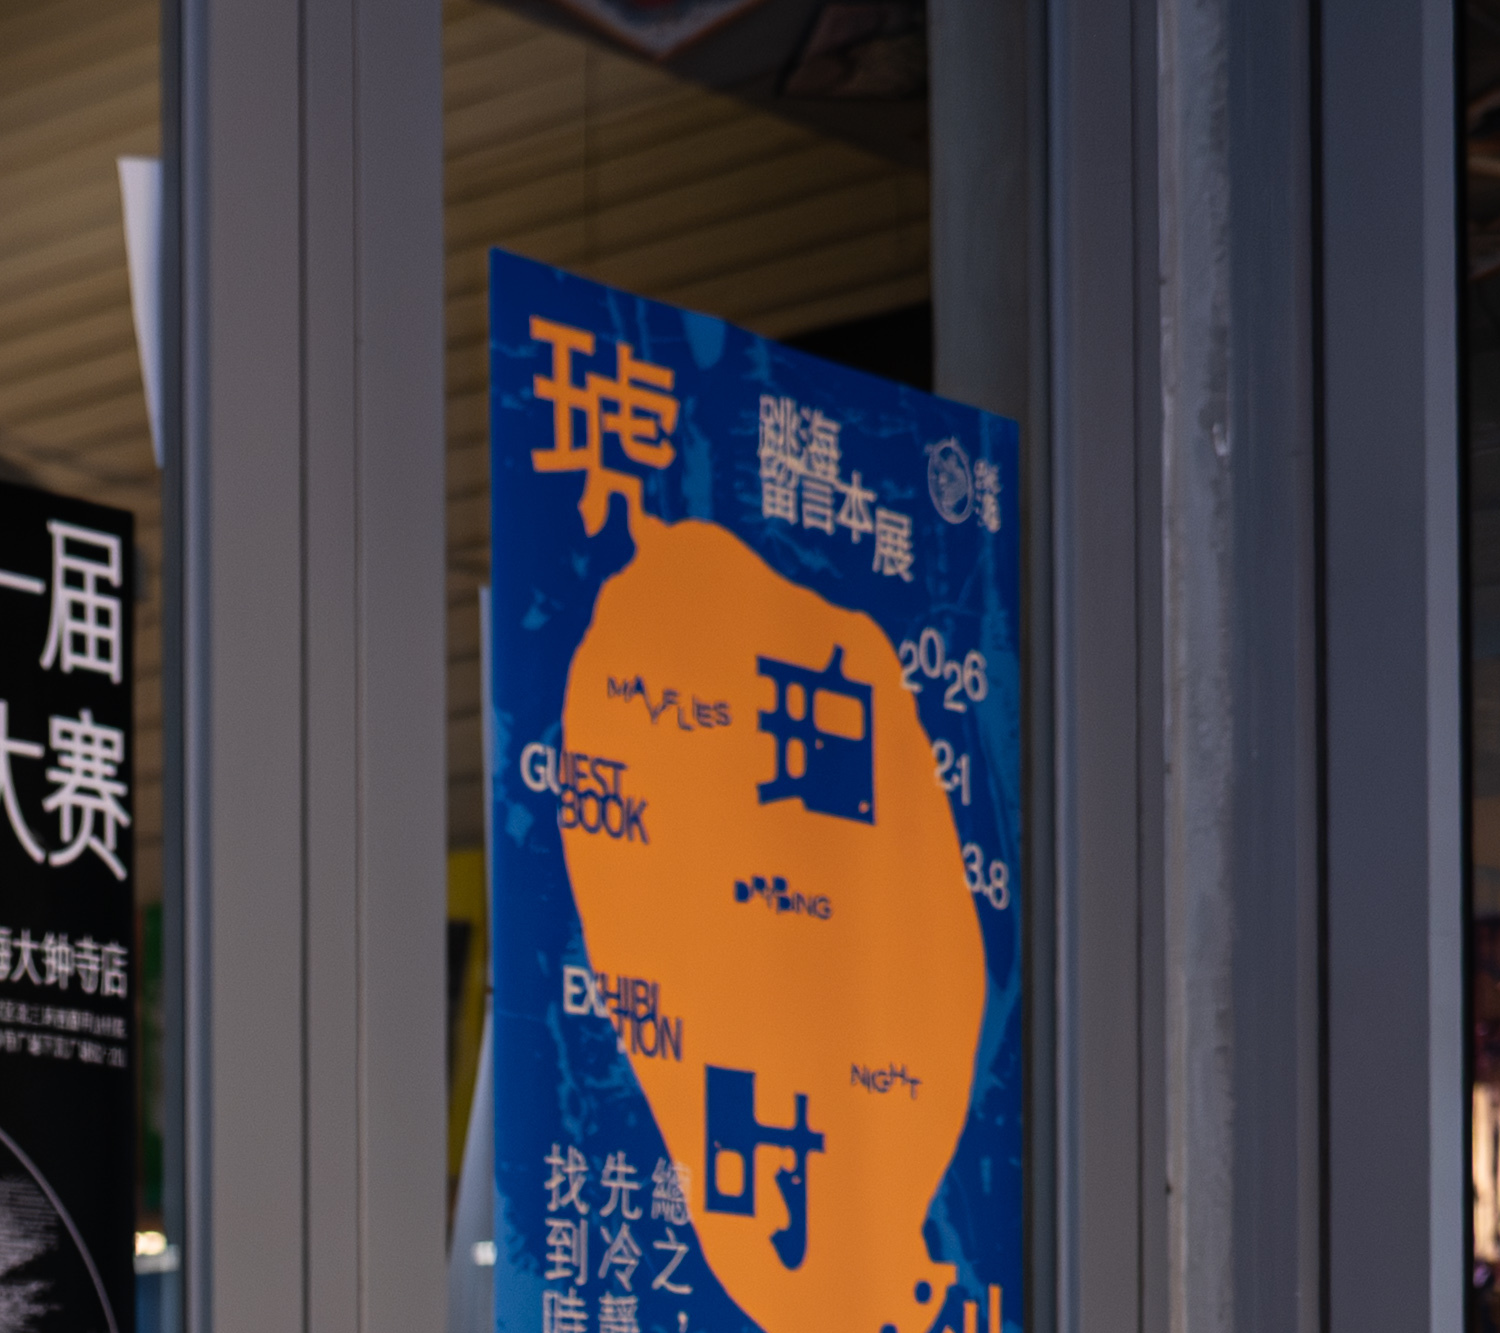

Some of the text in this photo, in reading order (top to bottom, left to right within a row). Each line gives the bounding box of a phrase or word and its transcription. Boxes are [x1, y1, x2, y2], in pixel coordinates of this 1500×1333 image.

[899, 627, 989, 713] 2026
[520, 741, 629, 797] GUEST
[557, 783, 650, 846] BOOK
[850, 1062, 922, 1100] NIGHT
